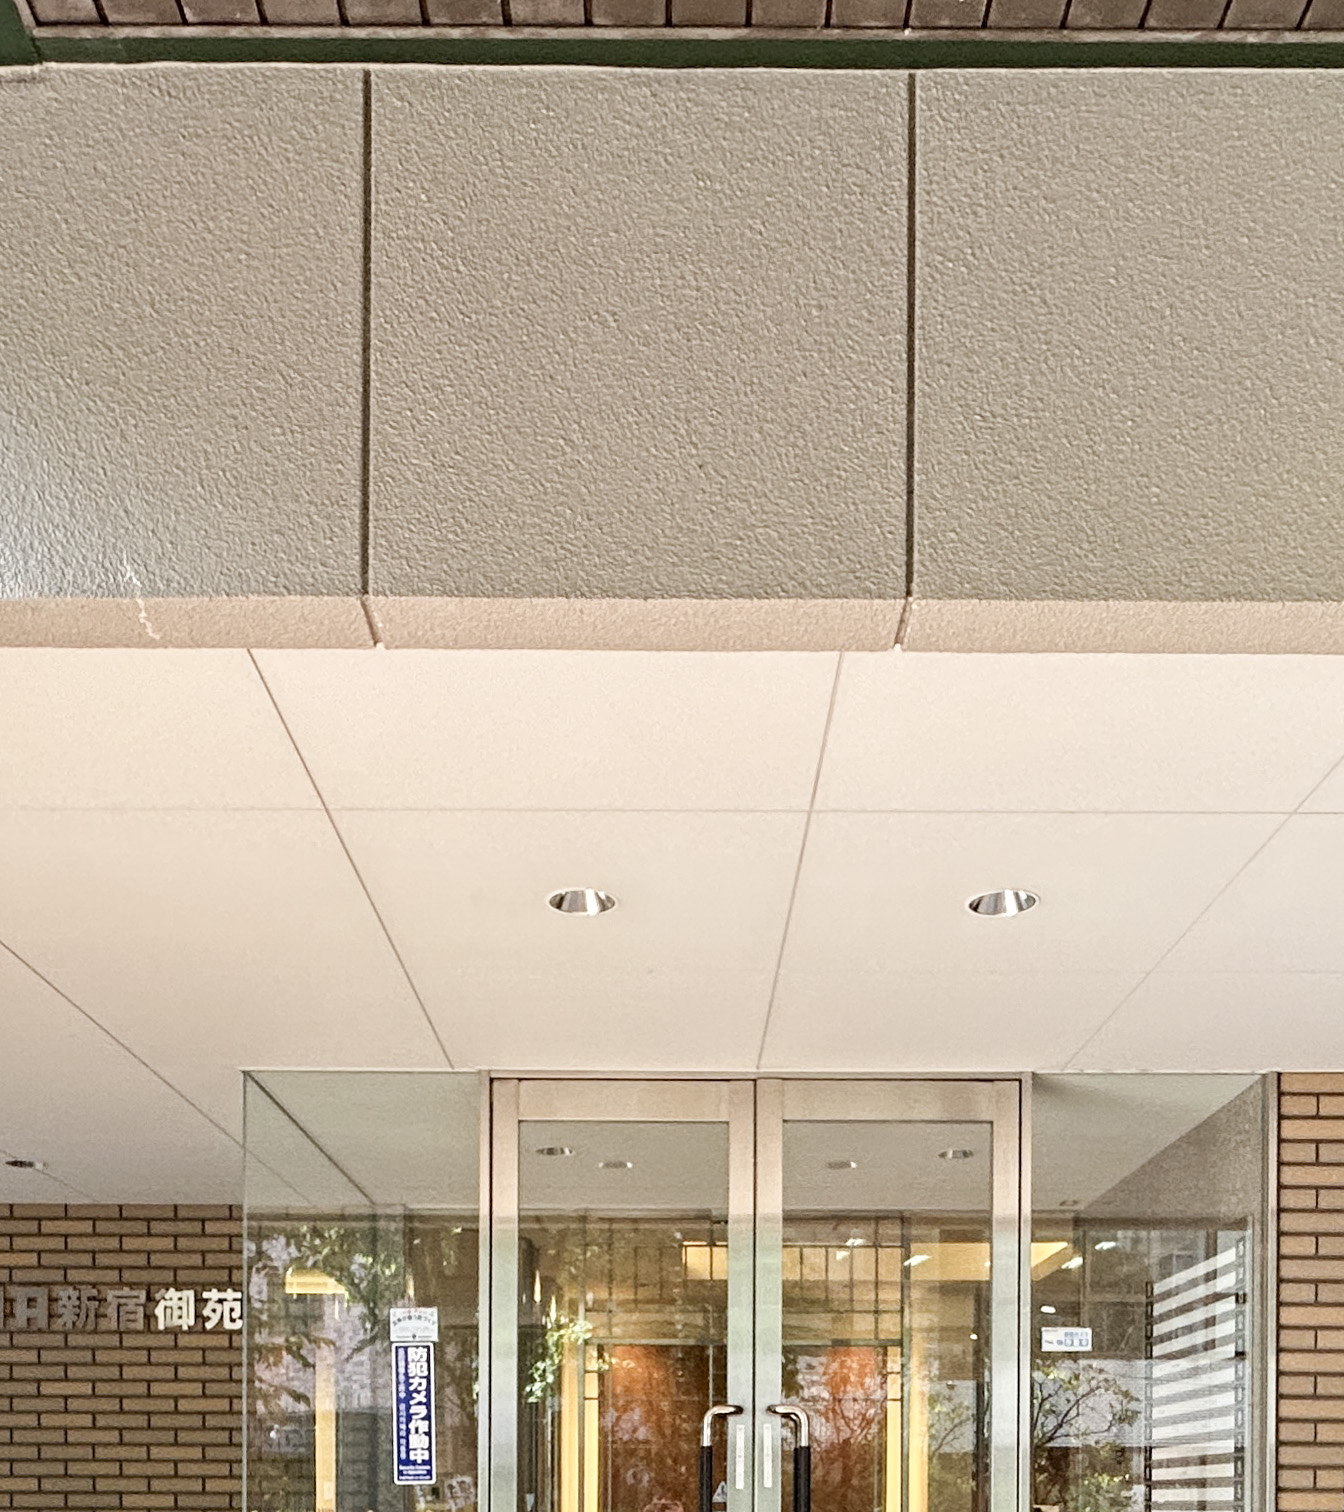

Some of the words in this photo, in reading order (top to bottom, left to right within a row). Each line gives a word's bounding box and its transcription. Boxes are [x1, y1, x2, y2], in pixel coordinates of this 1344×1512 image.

[408, 1347, 429, 1464] 防犯カメラ作動中
